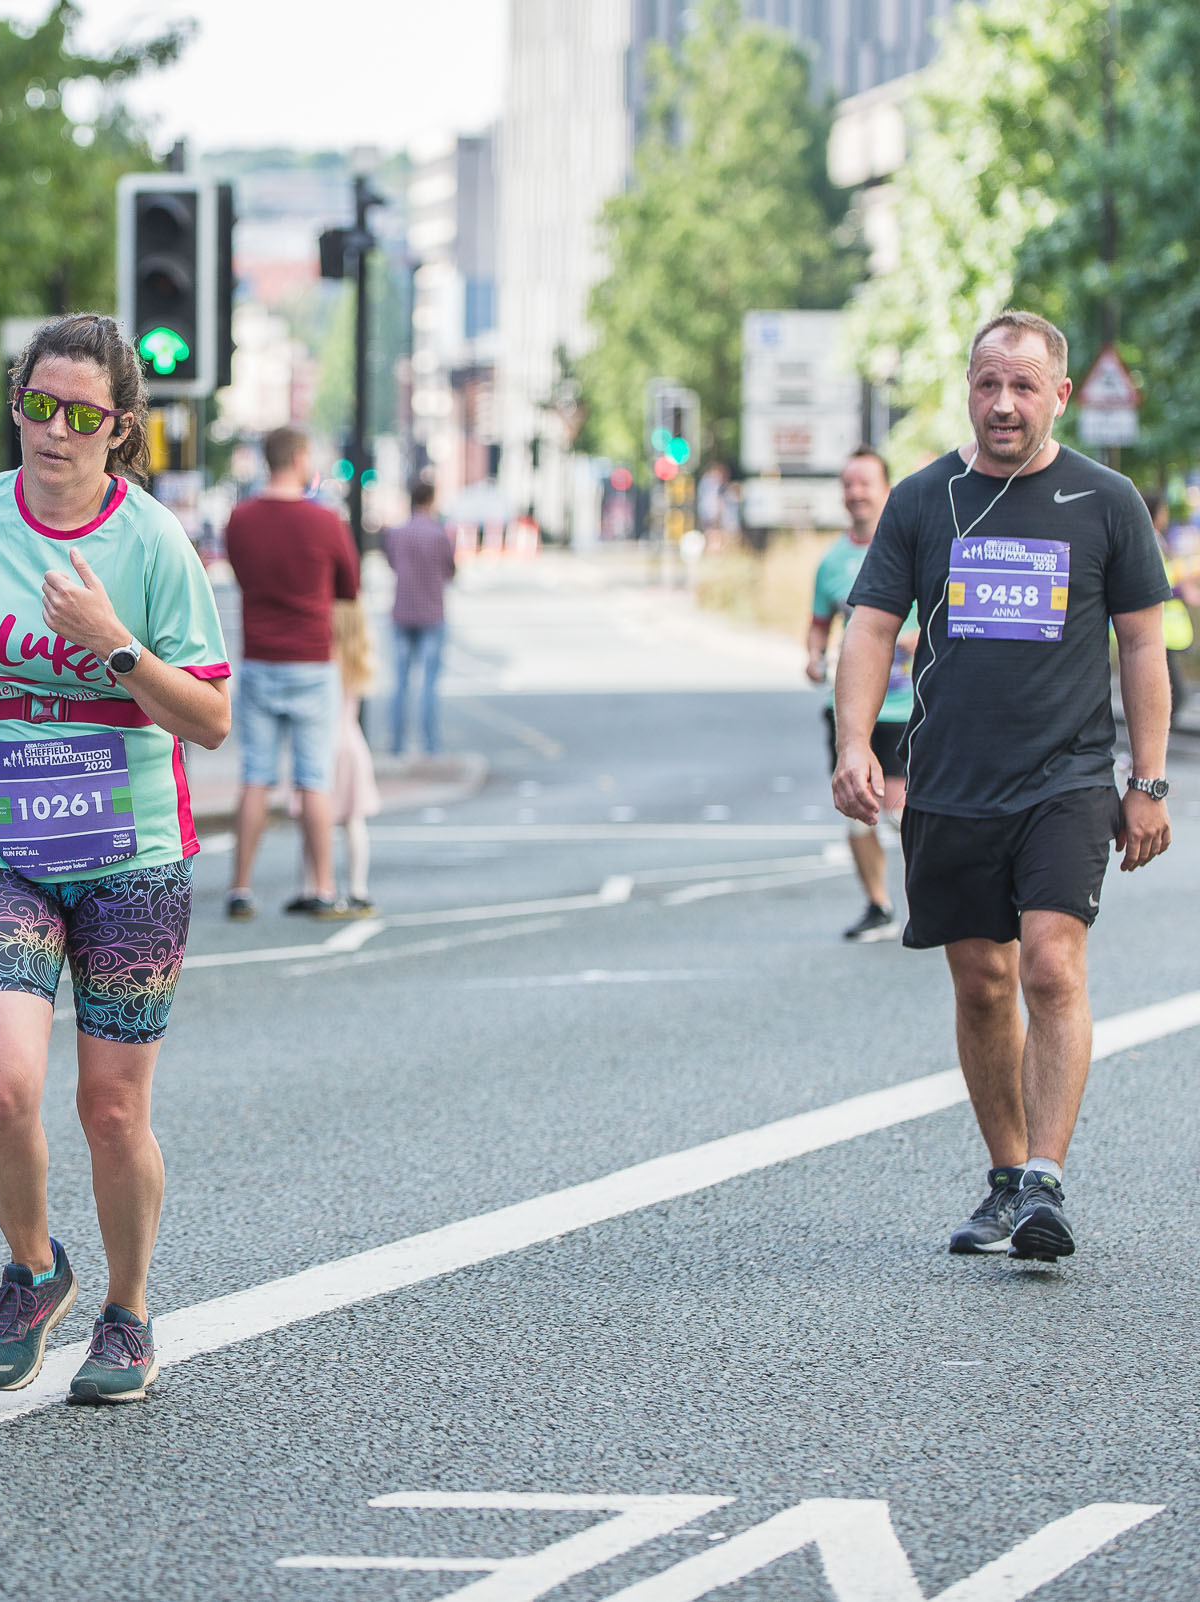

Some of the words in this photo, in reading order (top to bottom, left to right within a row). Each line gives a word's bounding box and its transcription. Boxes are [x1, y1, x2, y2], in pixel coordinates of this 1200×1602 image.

[986, 545, 1024, 553] SHEFFIELD
[985, 552, 1004, 560] HALF
[1006, 553, 1057, 563] MARATHON
[1033, 562, 1056, 571] 2020
[976, 584, 1039, 606] 9458
[992, 608, 1021, 617] ANNA
[25, 746, 71, 757] SHEFFIELD
[26, 757, 50, 767] HALF
[52, 750, 110, 765] MARATHON
[84, 760, 112, 771] 2020
[18, 791, 103, 820] 10261
